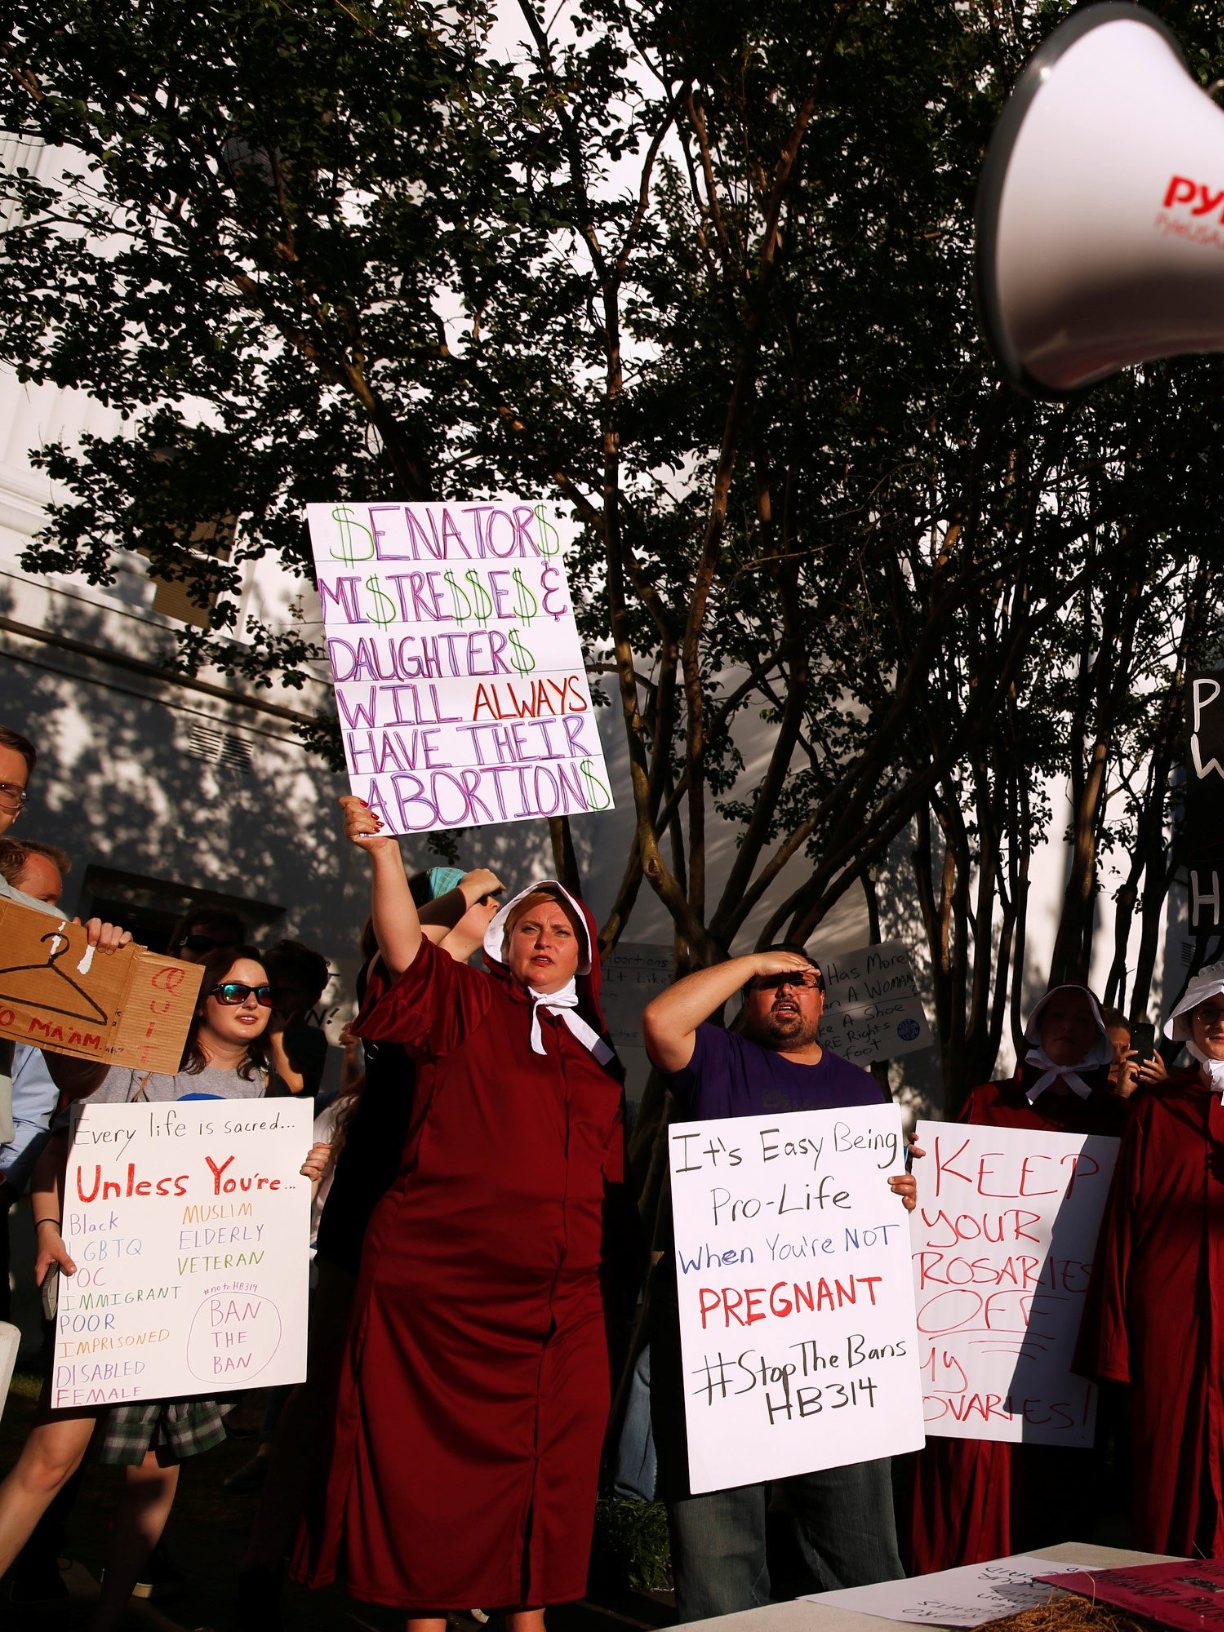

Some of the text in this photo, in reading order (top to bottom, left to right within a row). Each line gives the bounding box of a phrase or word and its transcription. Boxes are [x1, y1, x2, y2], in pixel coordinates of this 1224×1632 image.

[336, 675, 587, 729] WILL ALWAYS
[347, 715, 592, 774] HAVE THEIR
[827, 951, 908, 986] Has More
[848, 986, 858, 1002] A
[843, 1014, 854, 1028] A
[864, 1004, 905, 1021] Shoe
[847, 1022, 891, 1043] Rights
[73, 1110, 296, 1161] Every life is sacred...
[673, 1122, 897, 1173] It's Easy Being
[935, 1136, 1099, 1200] KEEP
[77, 1163, 189, 1203] Unless
[182, 1203, 252, 1225] MUSLIM
[711, 1175, 852, 1226] Pro-Life
[70, 1211, 119, 1236] Black
[179, 1225, 264, 1250] ELDERLY
[178, 1251, 265, 1276] VETERAN
[679, 1224, 900, 1275] When You're NOT
[61, 1286, 182, 1312] IMMIGRANT
[700, 1274, 883, 1329] PREGNANT
[916, 1289, 1070, 1334] OFF
[60, 1314, 115, 1335] POOR
[210, 1299, 262, 1328] BAN
[58, 1329, 170, 1359] IMPRISONED
[211, 1331, 248, 1348] THE
[56, 1361, 145, 1388] DISABLED
[213, 1353, 251, 1375] BAN
[56, 1386, 142, 1408] FEMALE
